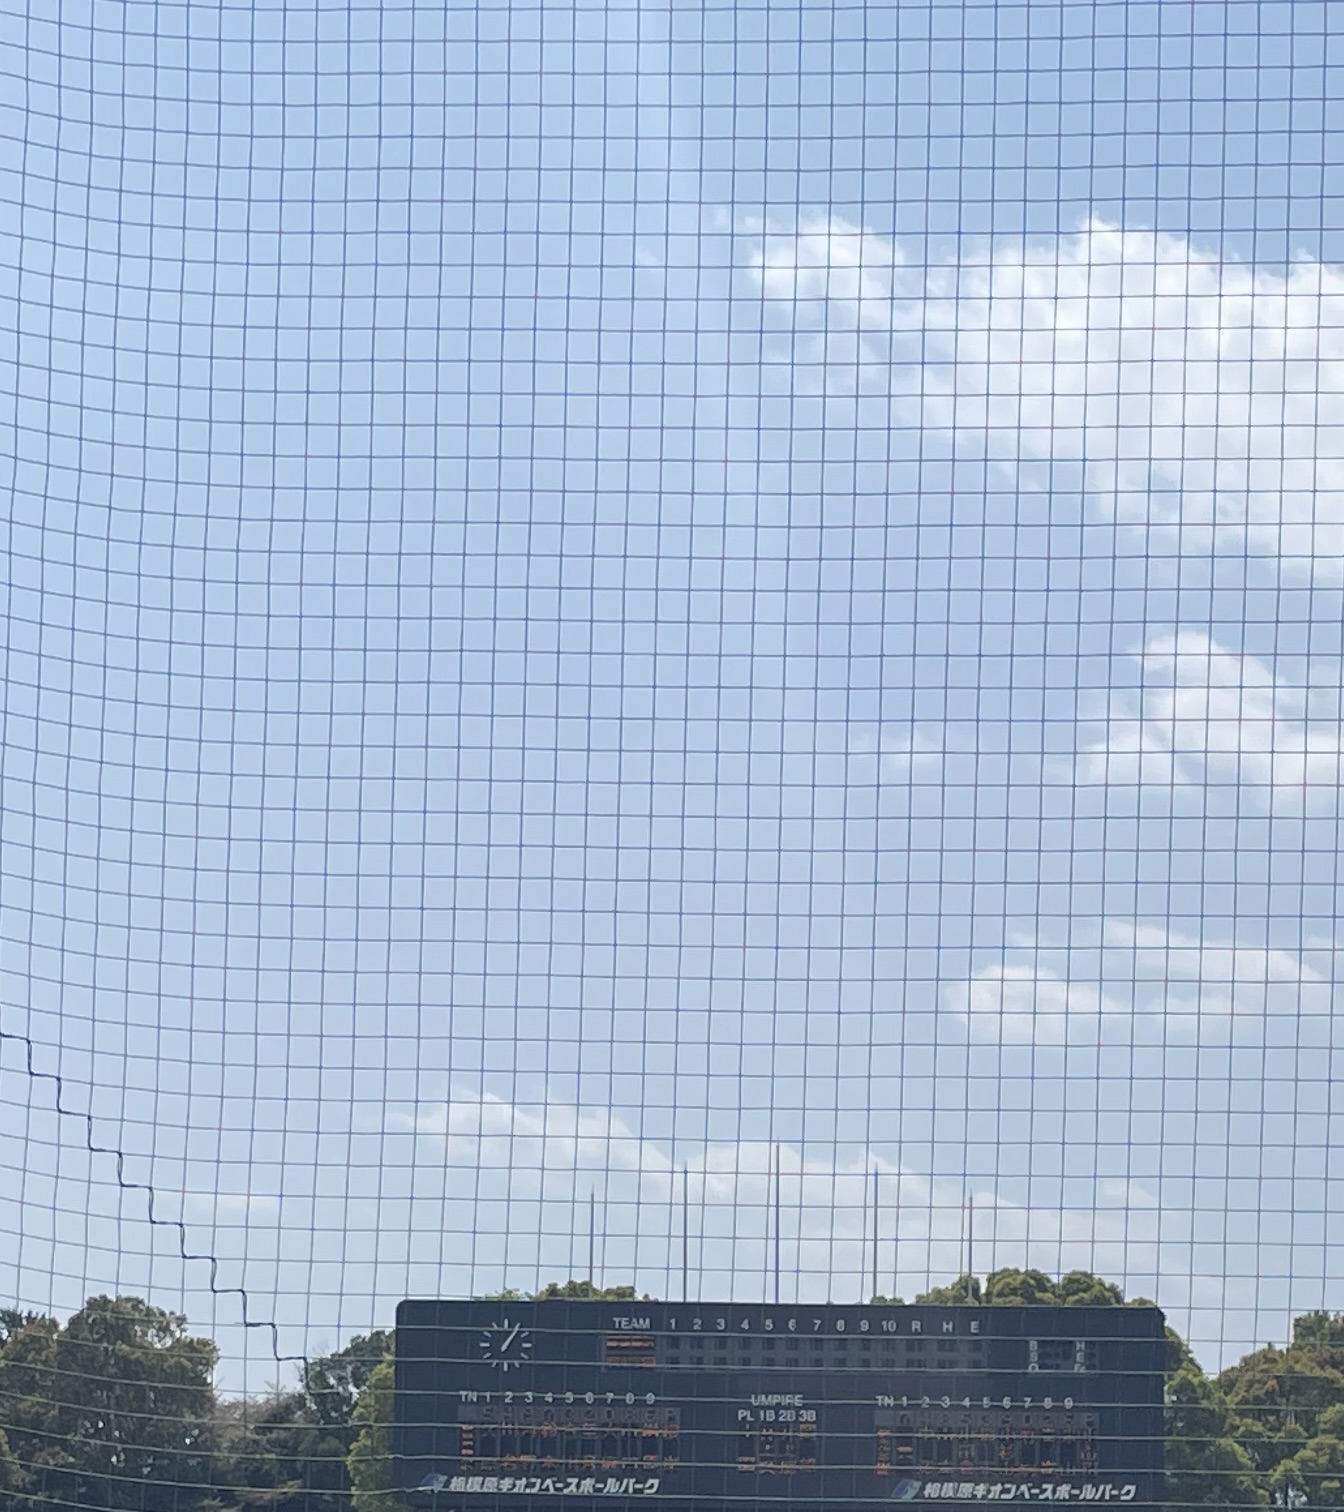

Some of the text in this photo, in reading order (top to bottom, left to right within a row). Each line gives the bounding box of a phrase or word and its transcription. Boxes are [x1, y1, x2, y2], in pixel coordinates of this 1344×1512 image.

[613, 1317, 980, 1333] TEAM 1 2 3 4 5 6 7 8 9 10 R H E
[1076, 1341, 1085, 1351] H
[1076, 1352, 1085, 1363] E
[459, 1391, 655, 1405] TN 1 2 3 4 5 6 7 8 9
[751, 1394, 804, 1407] UMPIRE
[876, 1396, 1073, 1409] TN 1 2 3 4 5 6 7 8 9
[738, 1410, 816, 1422] PL 1B 2B 3B
[449, 1476, 660, 1494] 相模原ギオンベースボールパーク
[923, 1481, 1137, 1501] 相模原ギオンベースボールパーク
